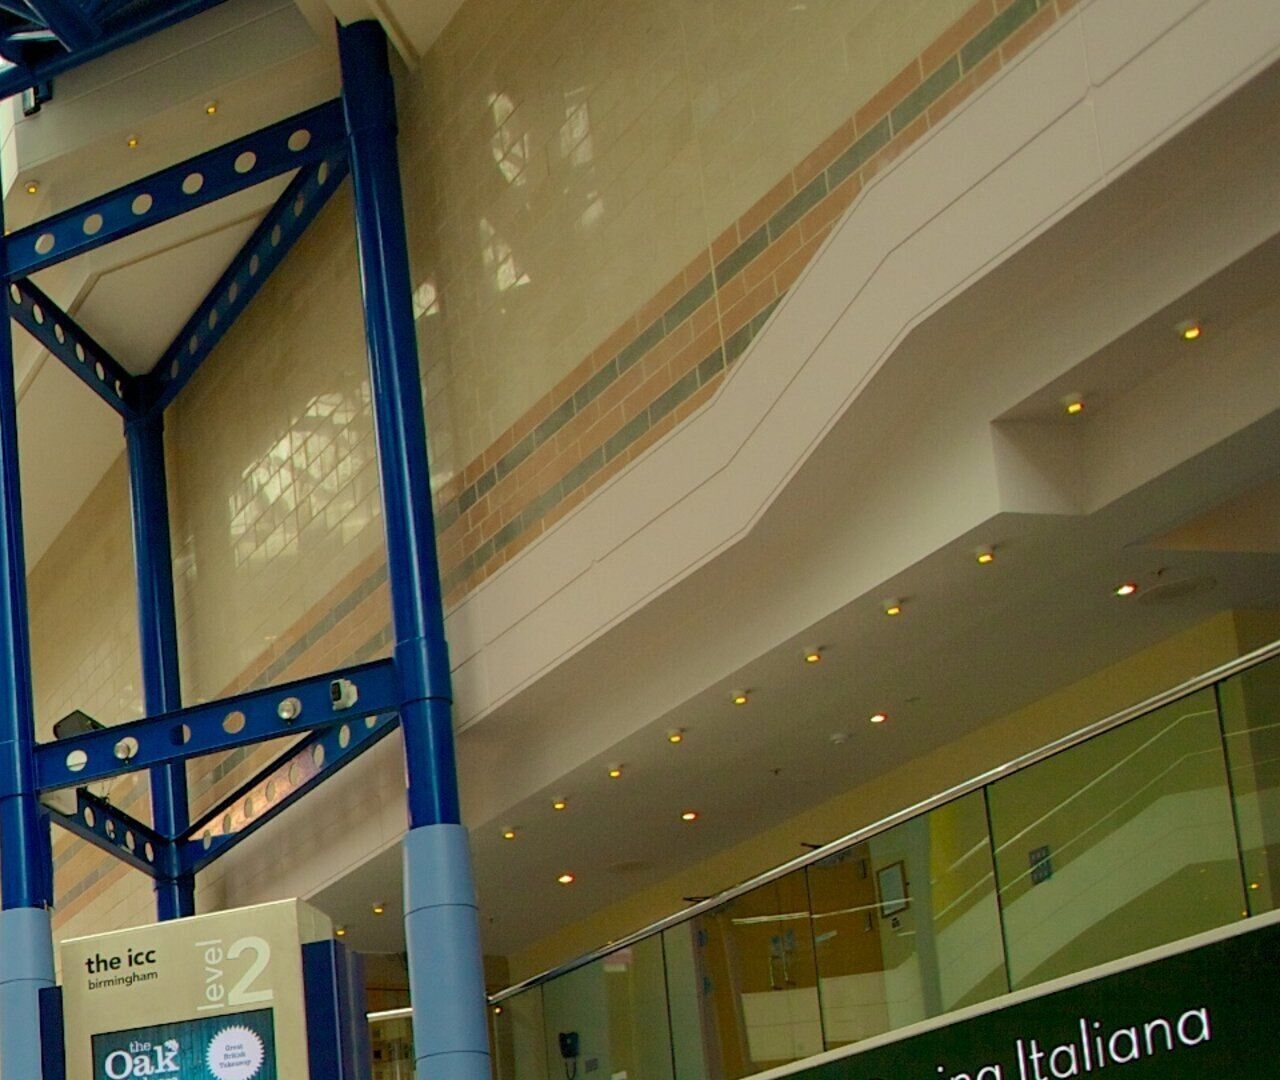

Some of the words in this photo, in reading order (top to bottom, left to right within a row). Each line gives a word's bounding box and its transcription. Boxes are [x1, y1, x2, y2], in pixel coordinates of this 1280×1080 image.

[85, 949, 123, 975] the
[127, 946, 157, 968] icc
[195, 939, 224, 1011] level
[227, 936, 274, 1007] 2
[87, 969, 159, 991] birmingham
[105, 1039, 180, 1080] Oak
[129, 1040, 151, 1053] the
